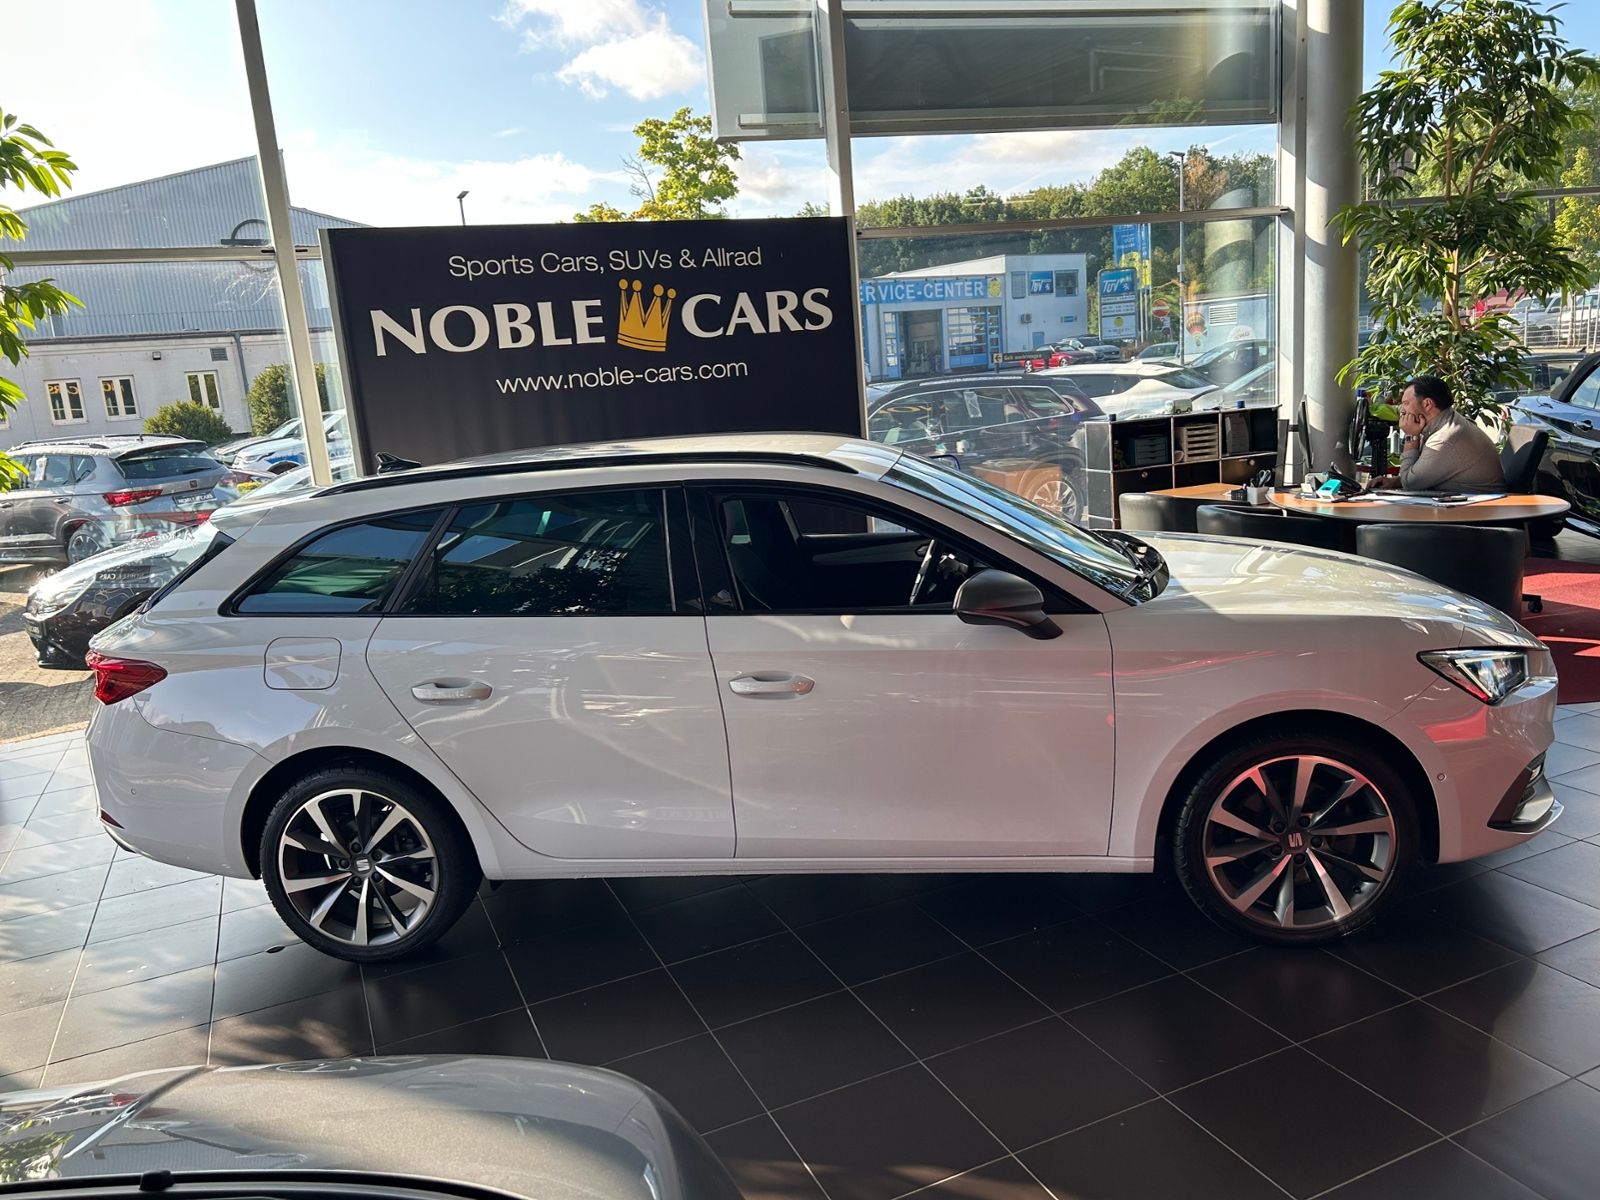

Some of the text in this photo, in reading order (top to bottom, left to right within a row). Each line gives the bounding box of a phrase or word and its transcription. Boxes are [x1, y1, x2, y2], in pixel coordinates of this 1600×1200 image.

[448, 246, 762, 282] Sports Cars, SUVs & Allrad
[369, 287, 833, 357] NOBLE CARS
[495, 362, 749, 394] www.noble-cars.com
